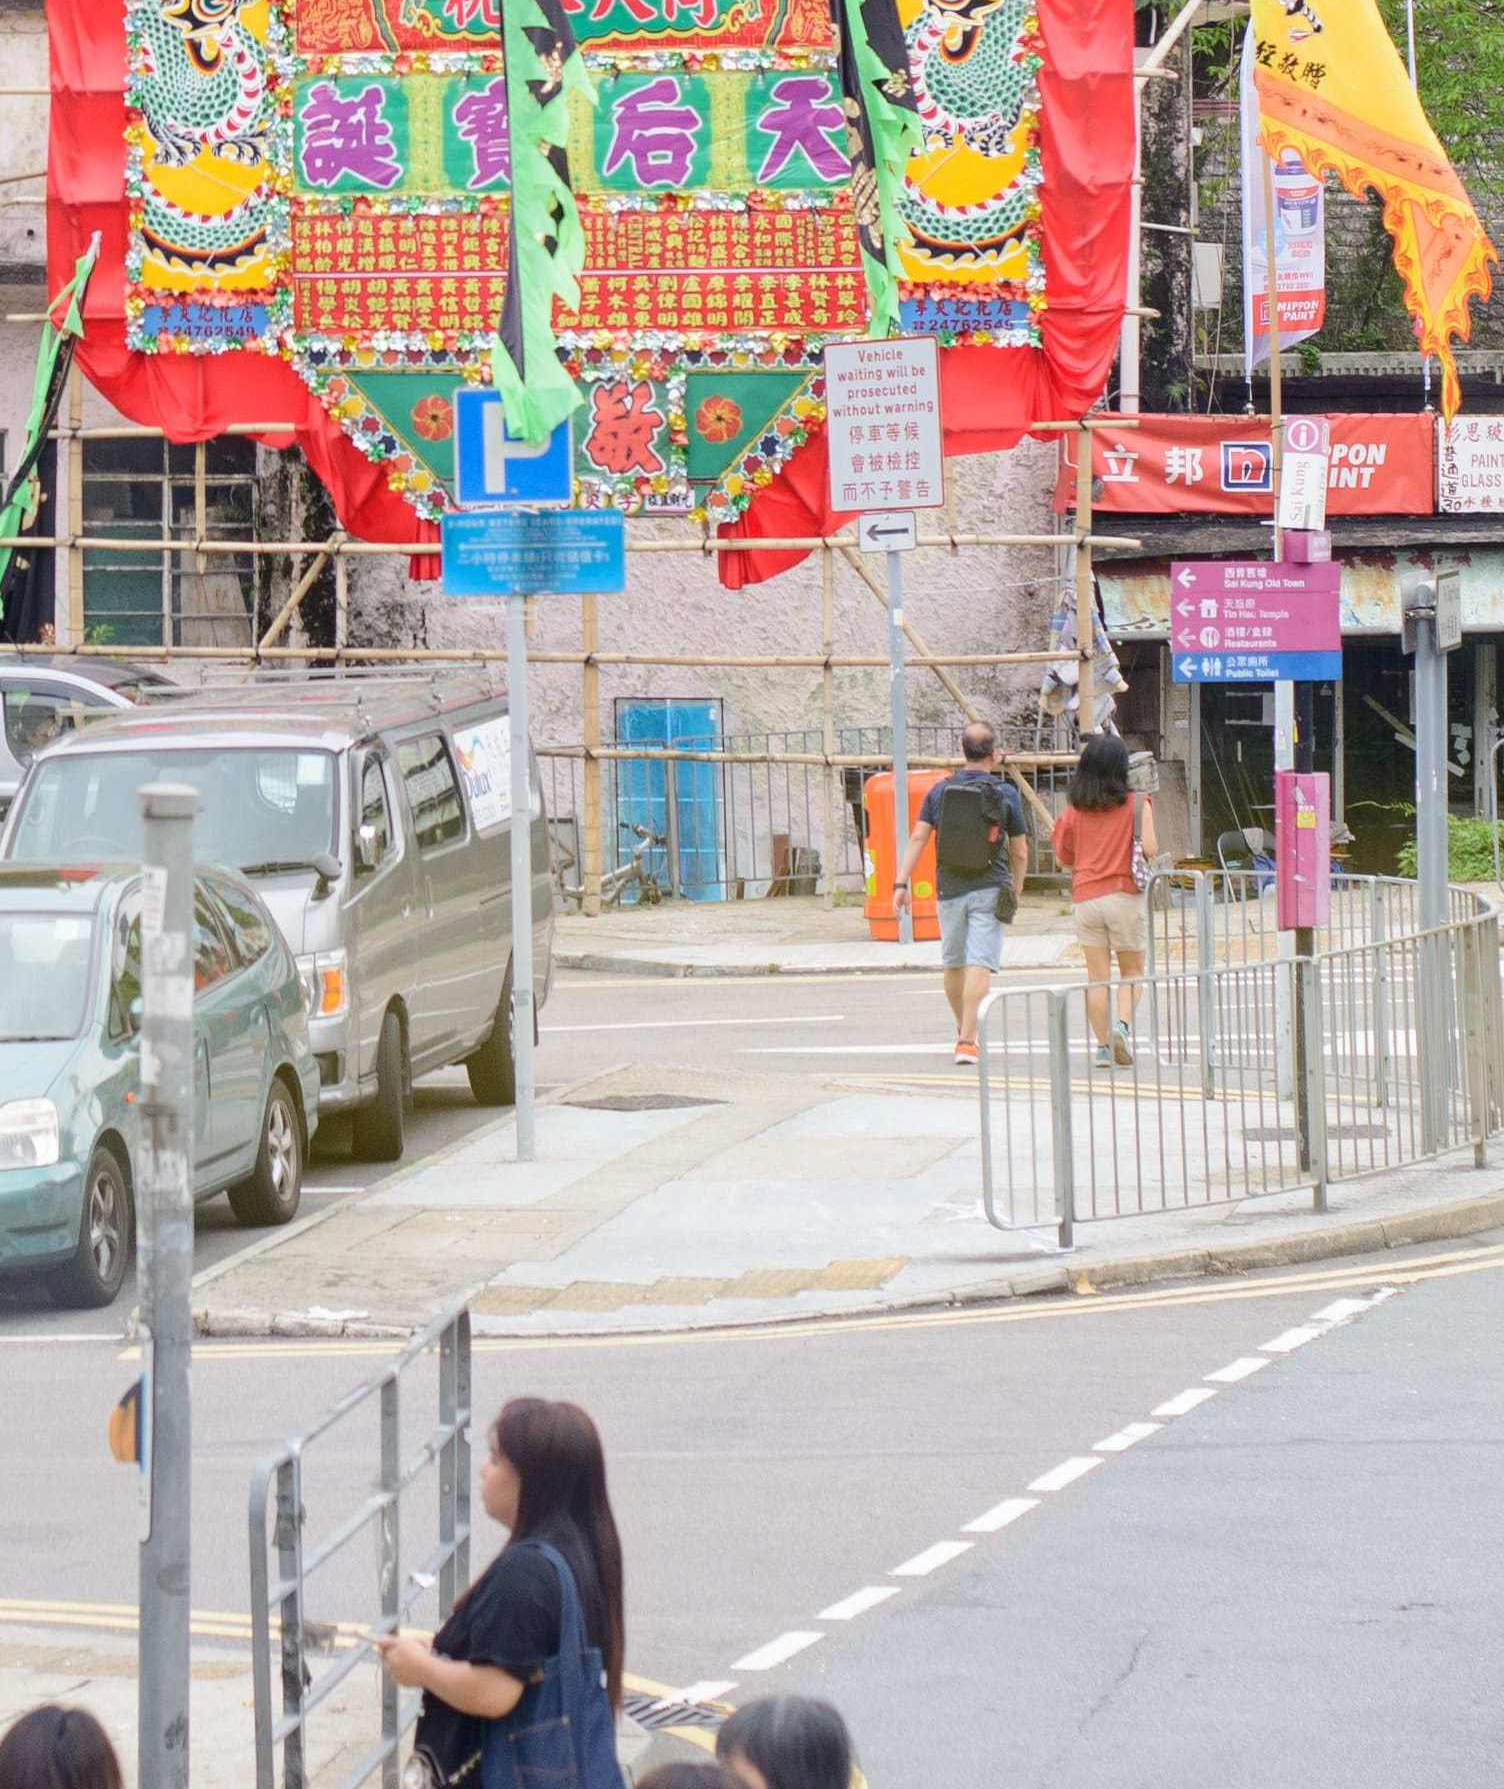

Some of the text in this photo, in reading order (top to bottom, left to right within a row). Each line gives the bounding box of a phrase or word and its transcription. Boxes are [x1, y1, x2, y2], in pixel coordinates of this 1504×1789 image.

[857, 349, 904, 363] Vehicle
[837, 363, 926, 382] waiting will be
[847, 382, 918, 399] prosecuted
[833, 399, 935, 418] without warning
[849, 421, 920, 445] 停車等候
[851, 450, 921, 474] 會被檢控
[1102, 443, 1204, 487] 立邦
[1461, 472, 1502, 488] GLASS
[842, 479, 931, 502] 而不予警告
[1224, 578, 1305, 590] Sai Kung Old Town
[1258, 609, 1290, 620] Temple
[1224, 638, 1278, 648] Restaurants
[1225, 668, 1280, 679] Public Toilet
